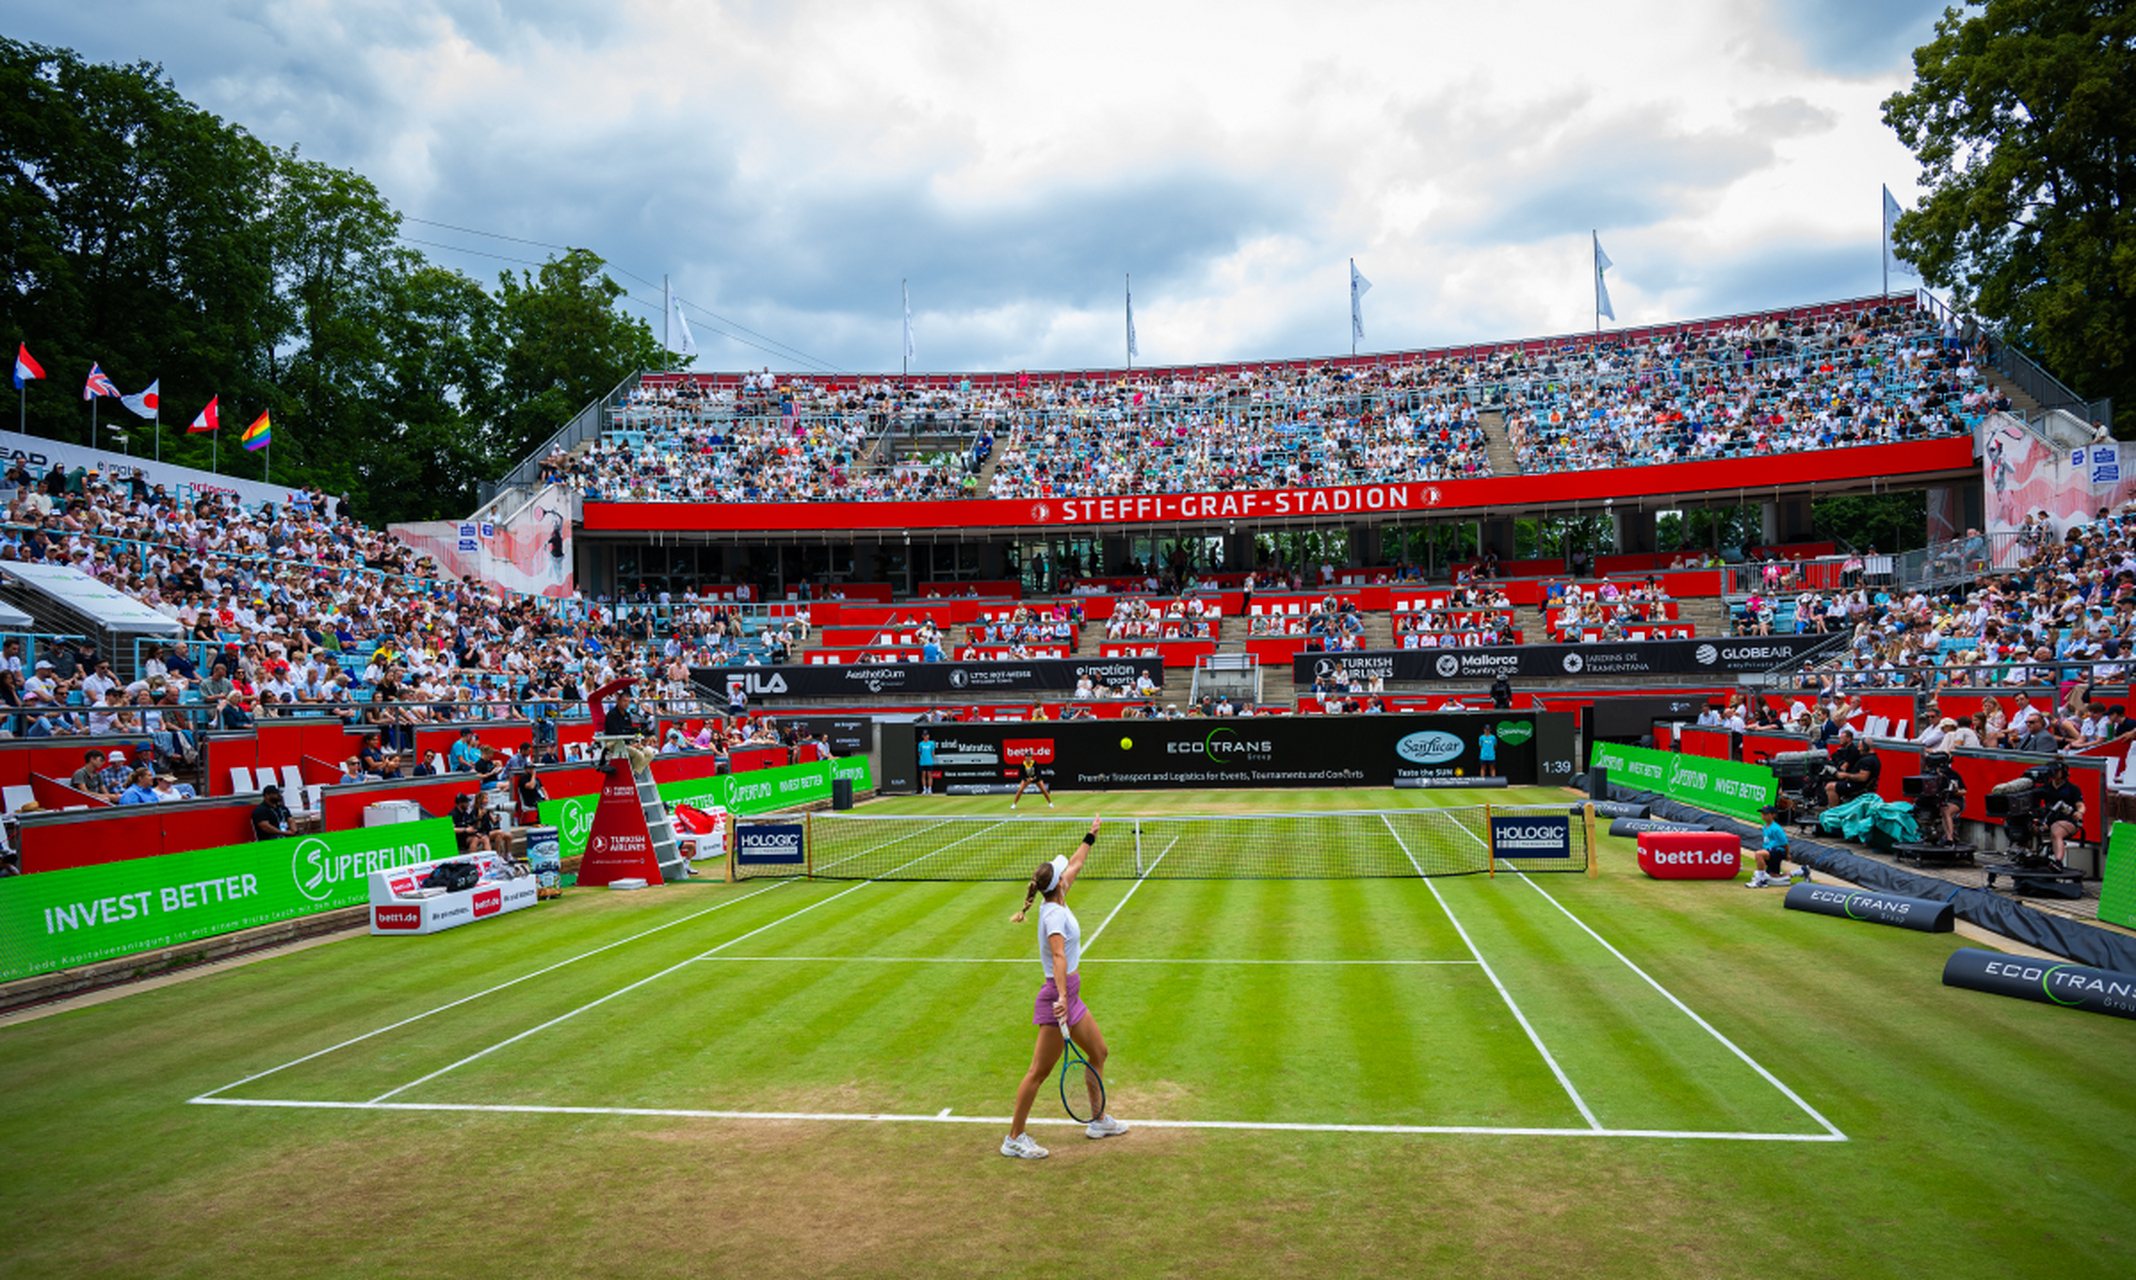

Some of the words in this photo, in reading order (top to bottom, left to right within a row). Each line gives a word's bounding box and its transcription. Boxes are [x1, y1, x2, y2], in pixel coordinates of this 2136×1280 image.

[1062, 486, 1408, 521] STEFFI-GRAF-STADION
[1721, 646, 1793, 660] GLOBEAIR
[1341, 657, 1393, 668] TURKISH
[1462, 655, 1518, 666] Mallorca
[1347, 667, 1393, 679] IRLINES
[1462, 666, 1495, 676] Country
[726, 673, 788, 694] FILA
[1420, 769, 1434, 777] the
[1436, 769, 1453, 777] SUN
[1542, 761, 1571, 774] 1:39
[1078, 774, 1110, 782] Premir
[1112, 772, 1150, 783] Transport
[1152, 772, 1168, 781] and
[1169, 772, 1205, 783] Logistics
[1206, 771, 1218, 781] for
[1251, 770, 1307, 780] Tournaments
[1308, 770, 1325, 779] and
[1714, 778, 1739, 797] INVEST
[1739, 782, 1767, 802] BETTER
[610, 835, 645, 843] TURKISH
[1496, 826, 1564, 839] HOLOGIC
[742, 834, 799, 846] HOLOGIC
[610, 843, 646, 851] AIRLINES
[1654, 850, 1734, 865] bett1.de
[305, 842, 431, 890] SUPERFUND
[44, 890, 152, 935] INVEST
[160, 873, 259, 913] BETTER
[379, 913, 417, 923] bett1.de
